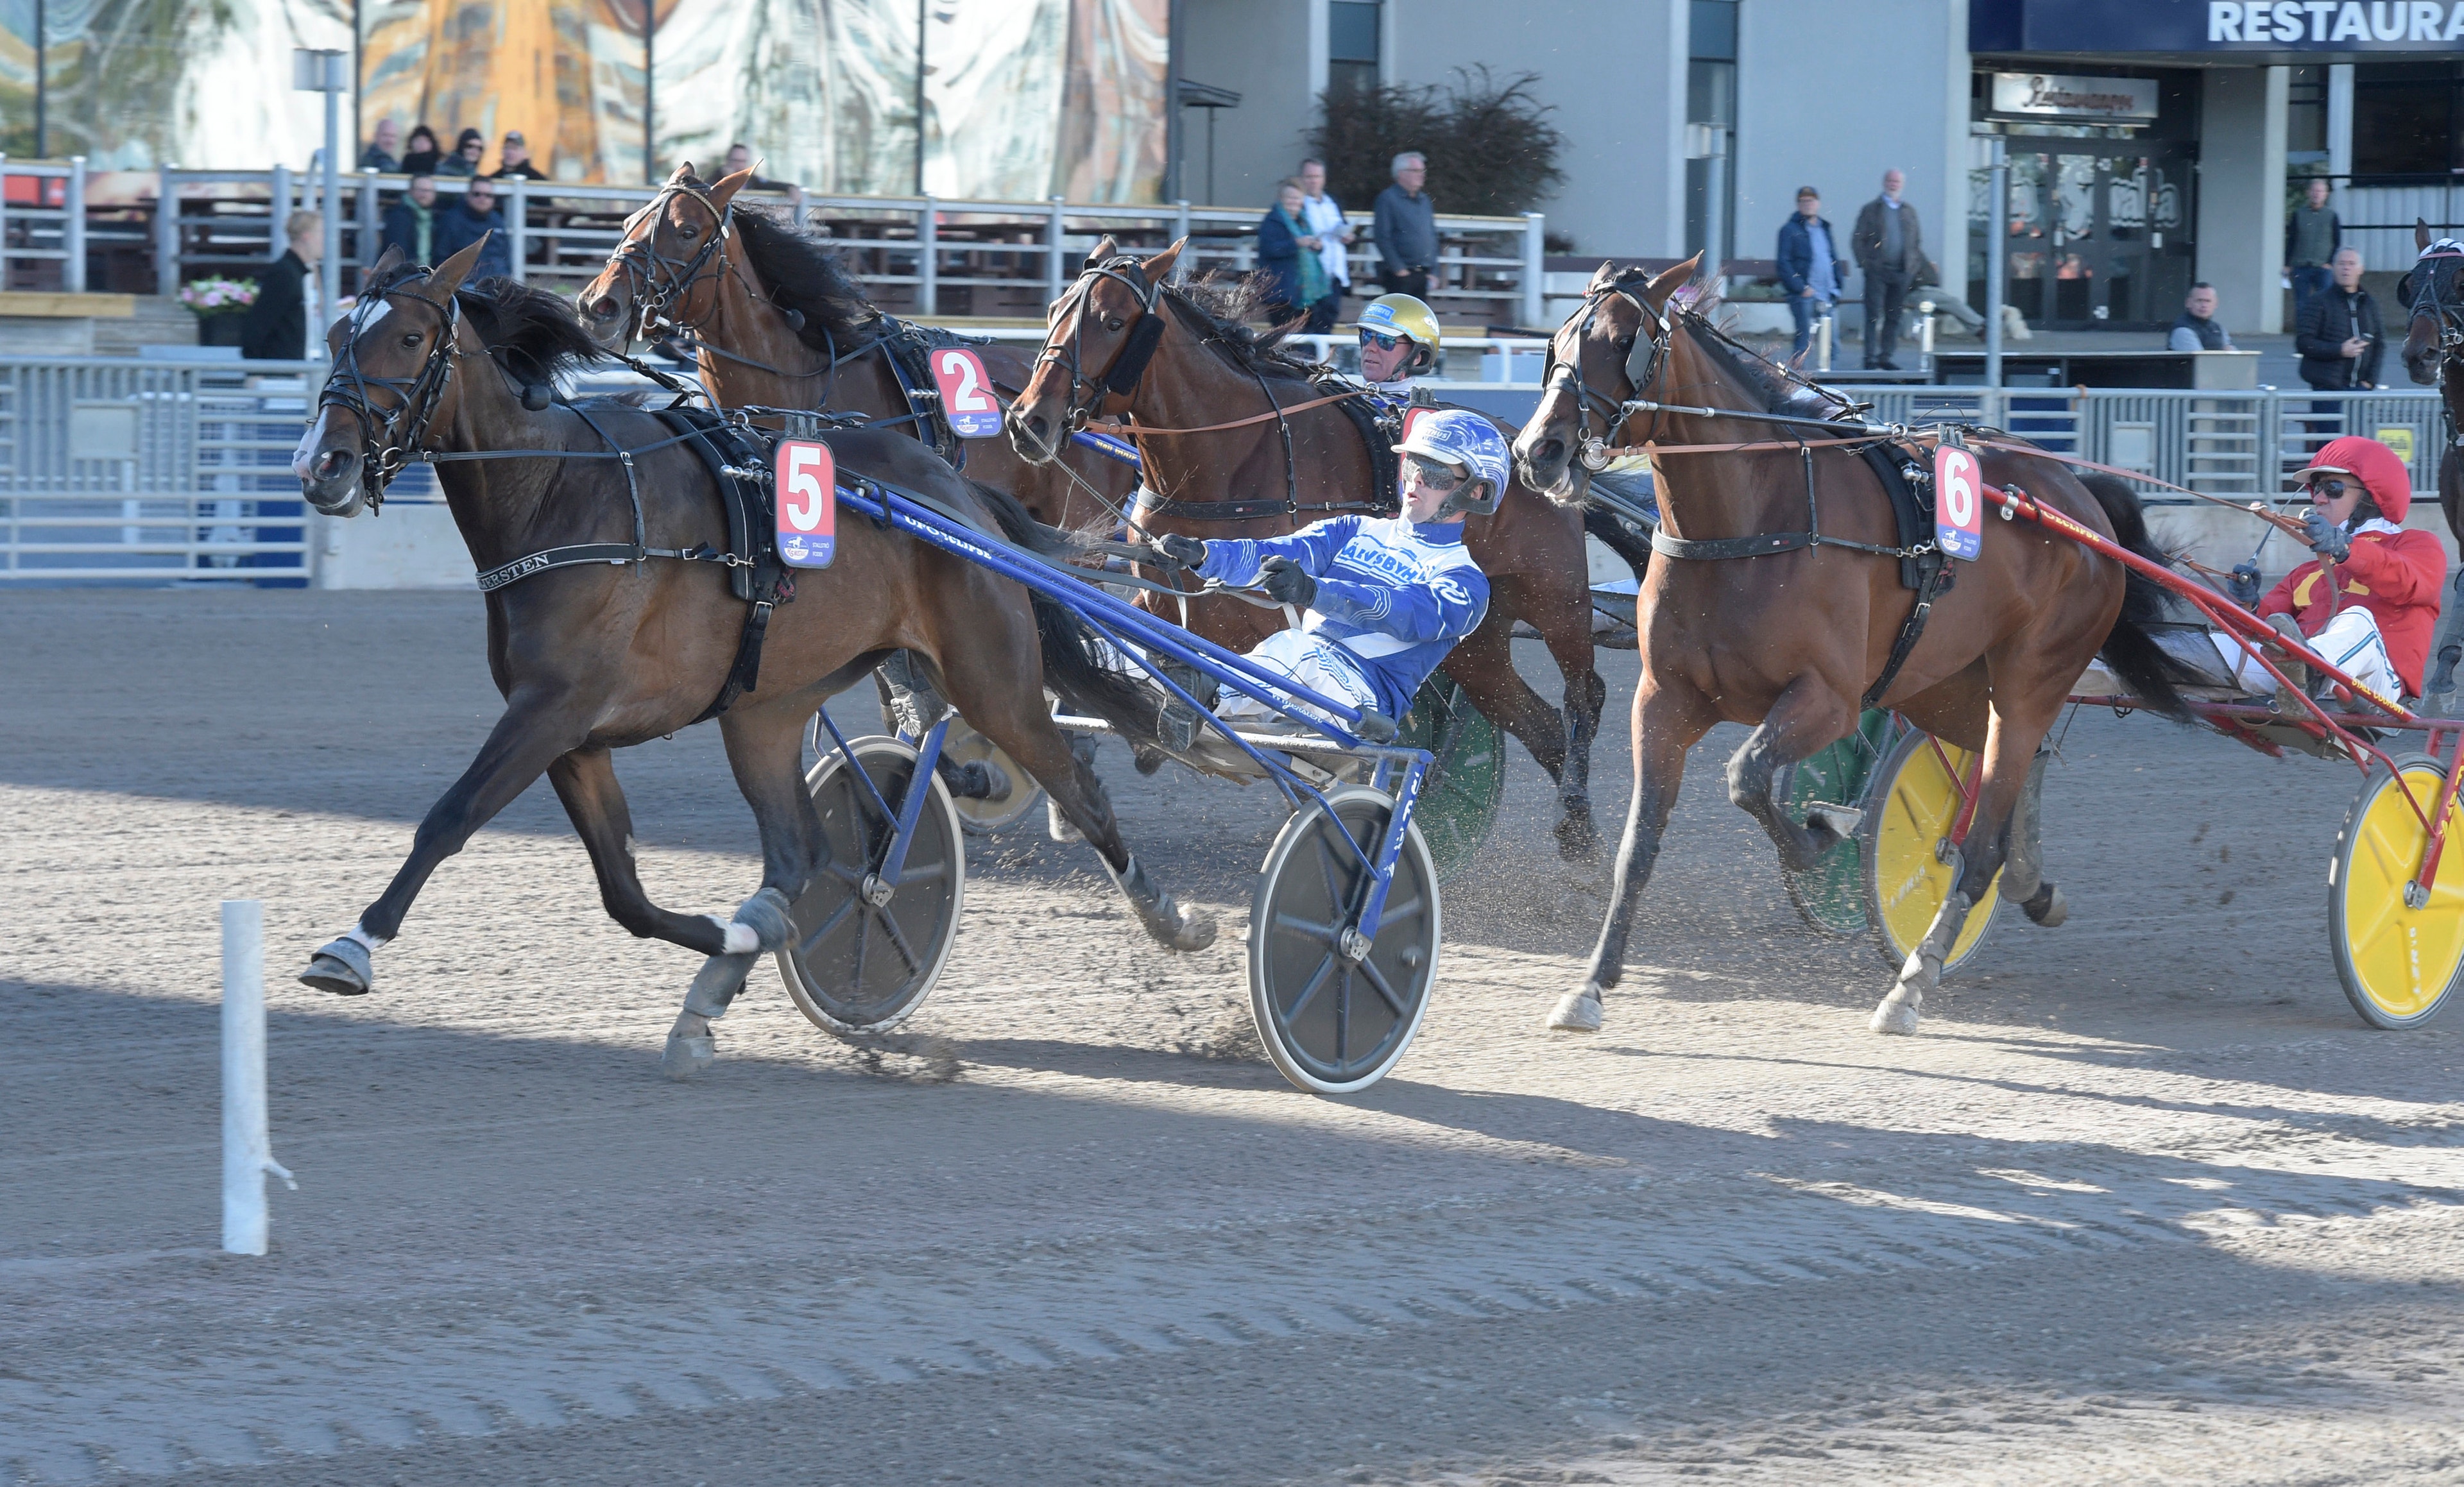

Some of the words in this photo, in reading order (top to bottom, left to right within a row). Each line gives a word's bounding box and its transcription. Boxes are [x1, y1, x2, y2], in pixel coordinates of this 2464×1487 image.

[942, 352, 988, 411] 2
[786, 445, 823, 531] 5
[1944, 451, 1973, 527] 6
